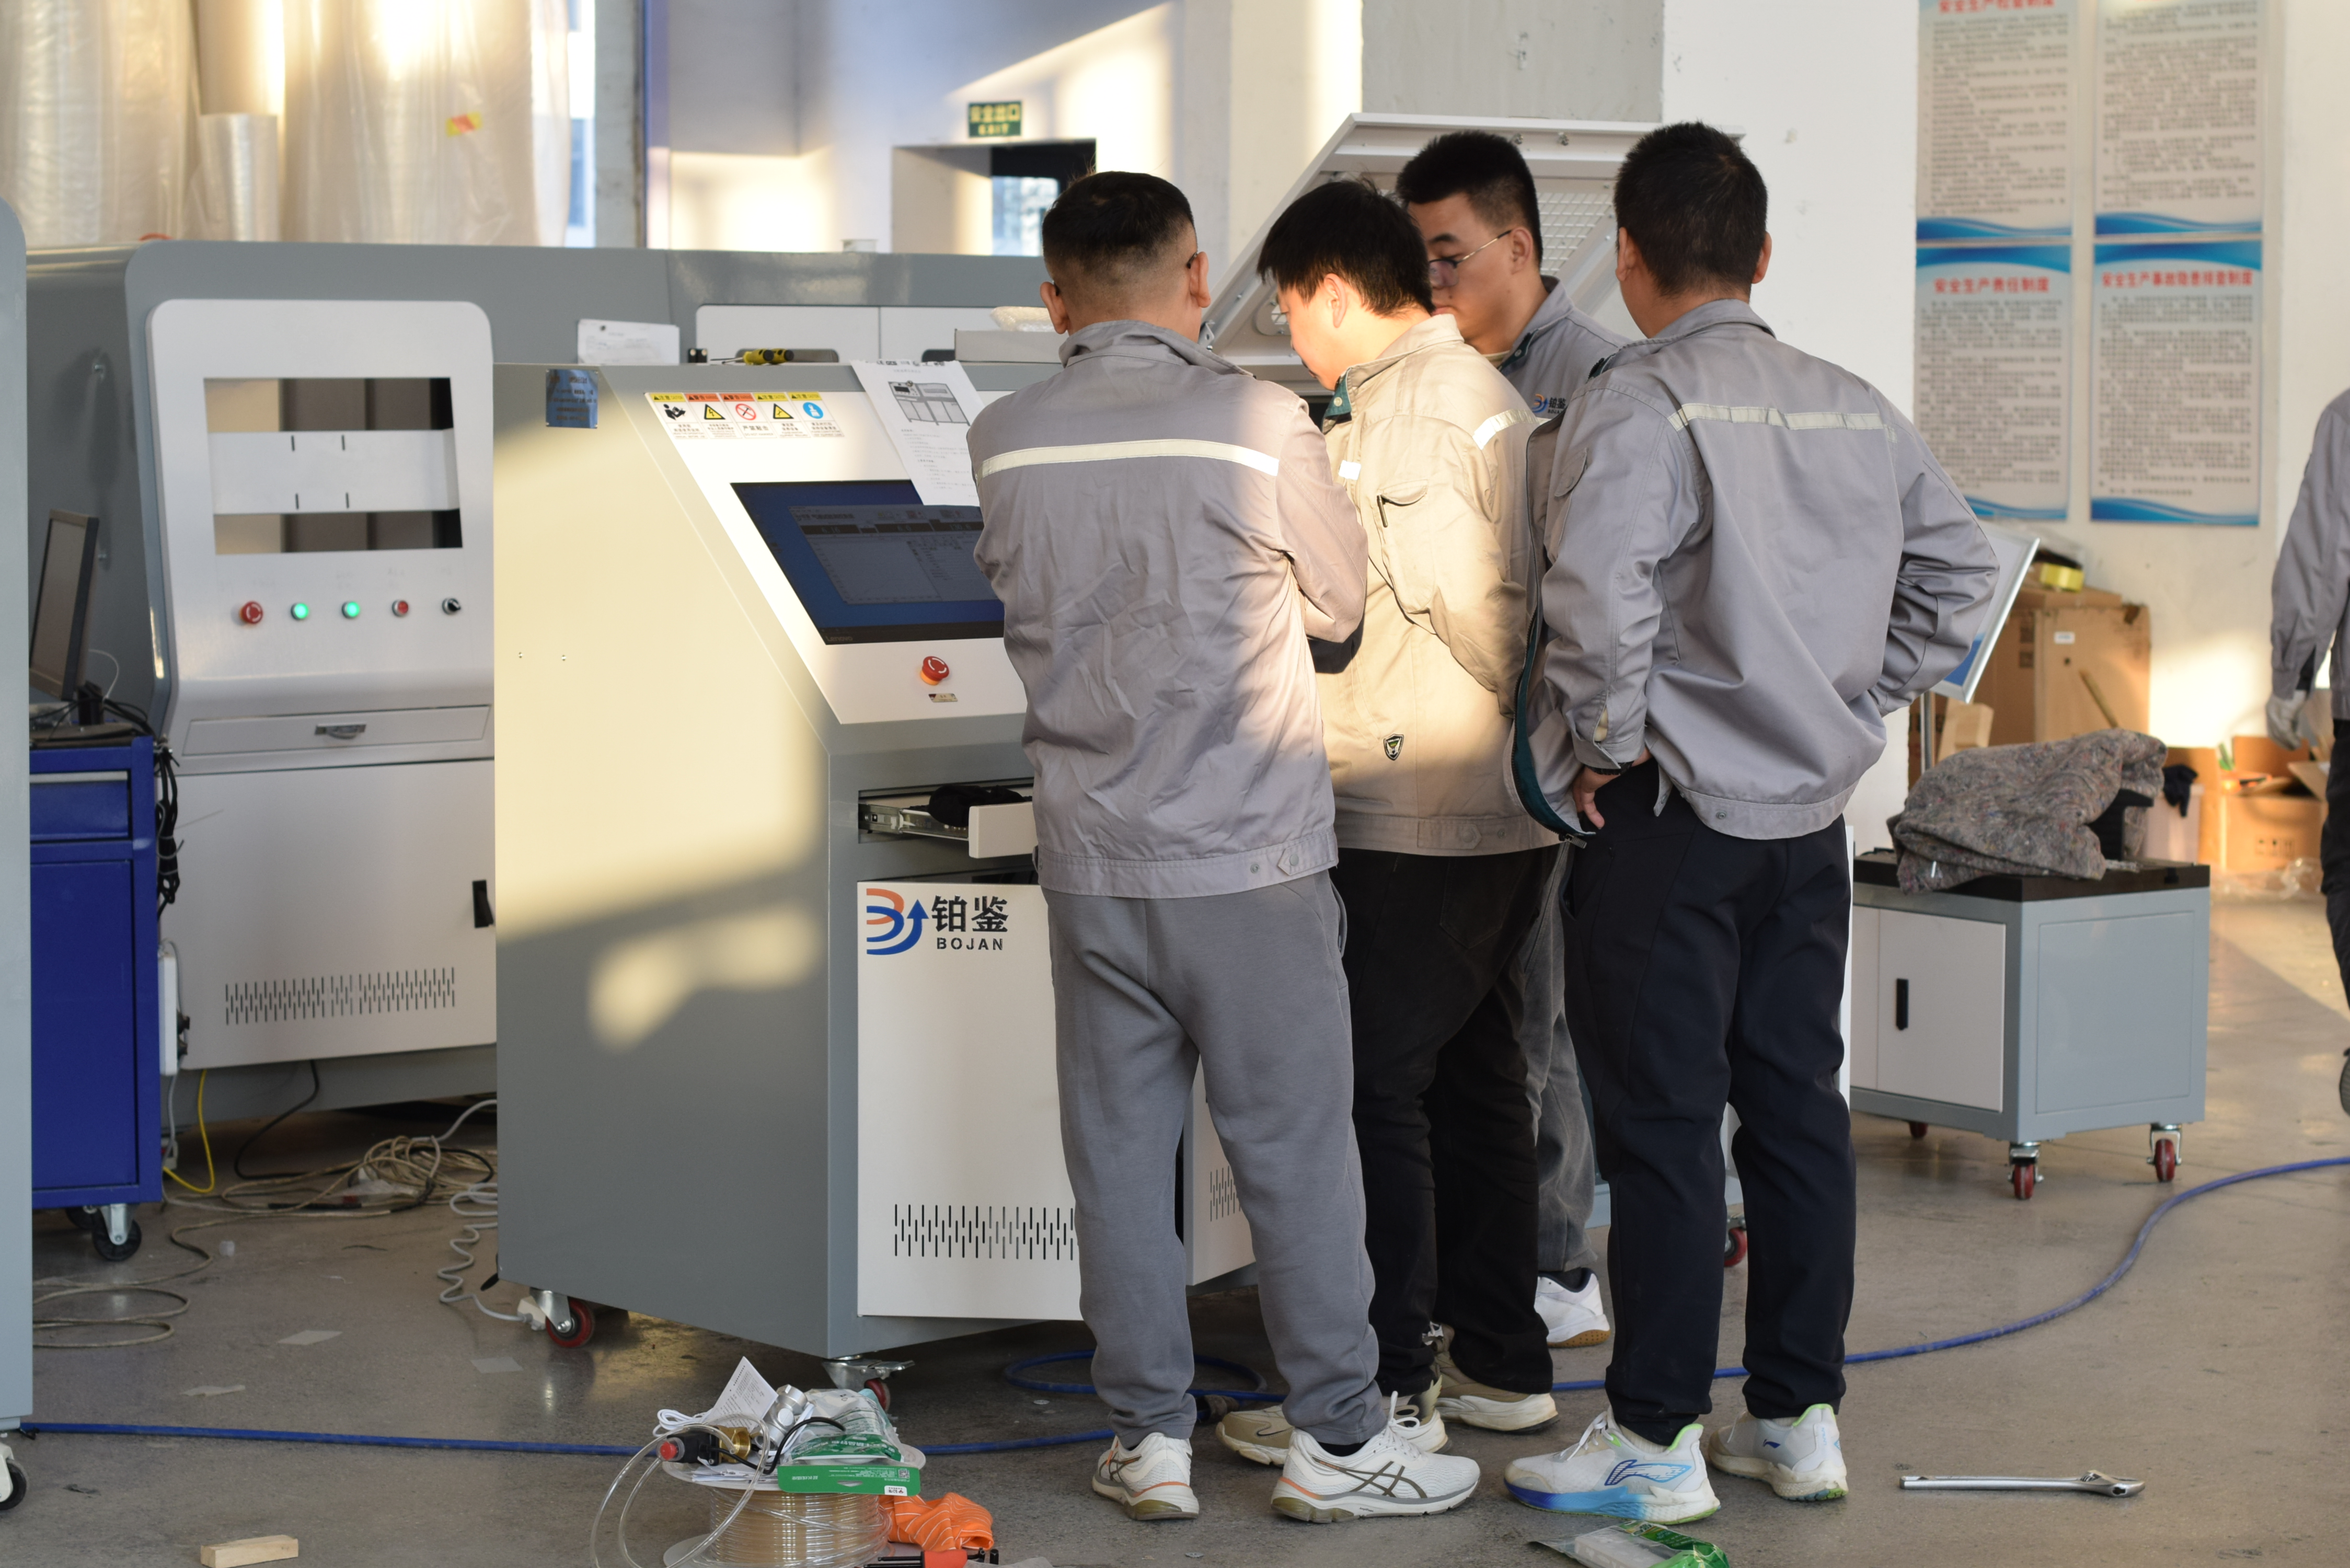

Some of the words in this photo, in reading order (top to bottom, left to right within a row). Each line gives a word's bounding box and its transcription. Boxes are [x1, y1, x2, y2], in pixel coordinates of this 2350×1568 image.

[1549, 397, 1566, 409] 铂鉴
[931, 894, 1009, 932] 铂鉴
[937, 938, 1003, 950] BOJAN
